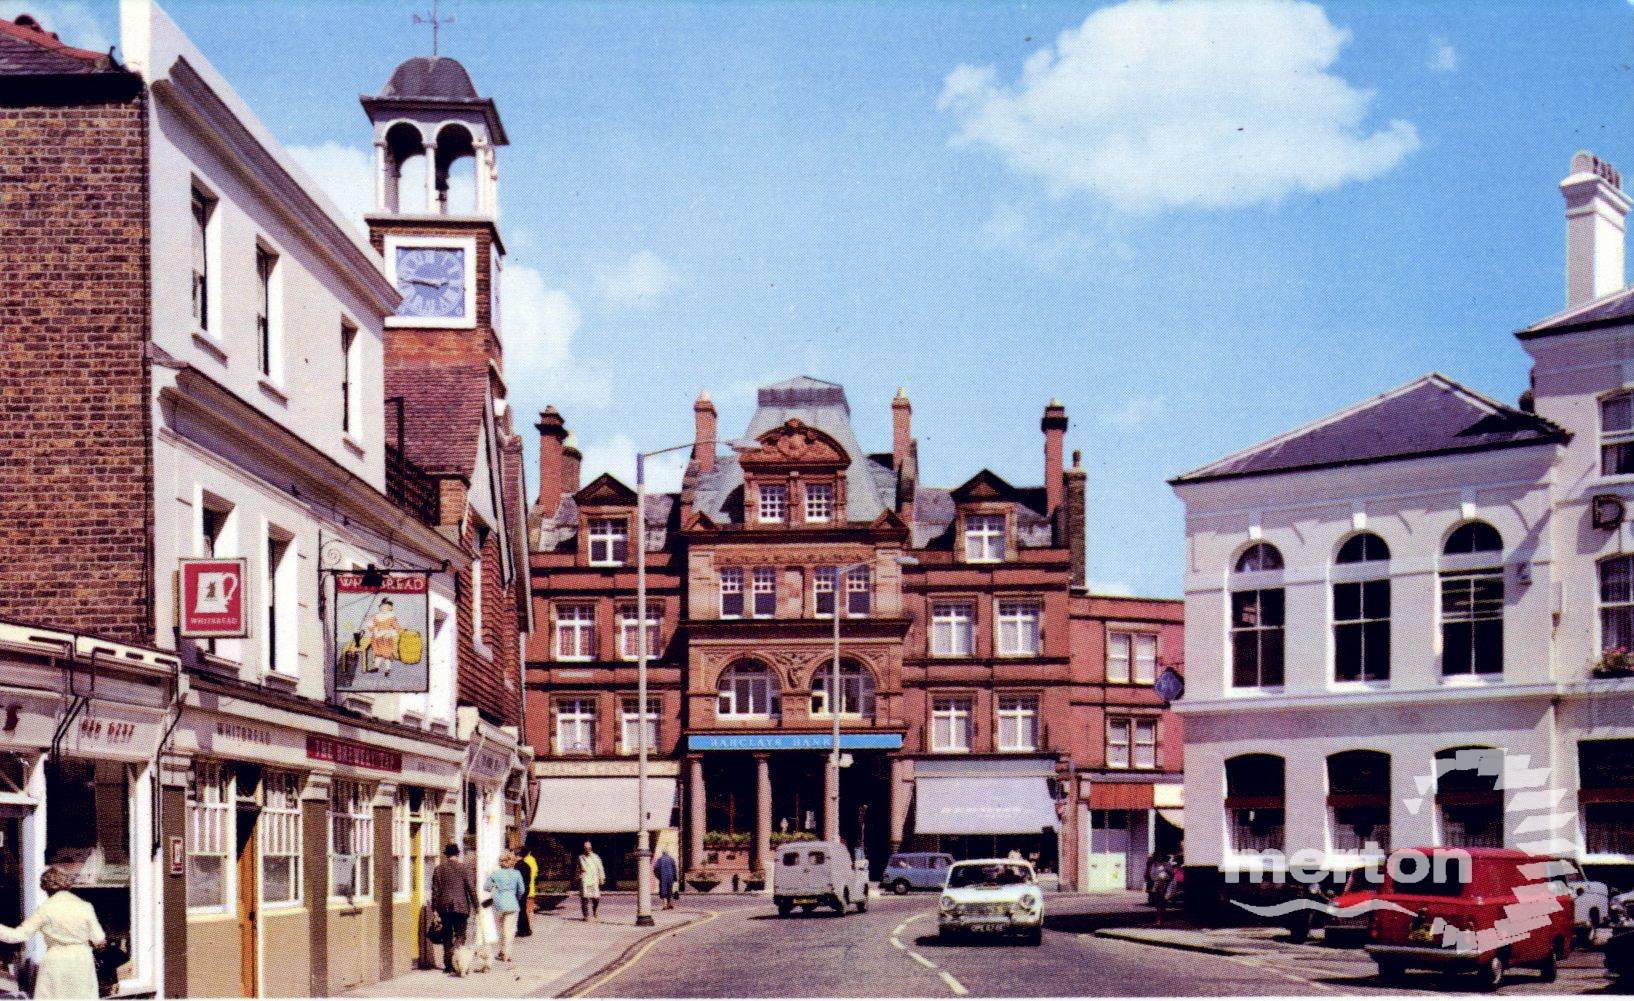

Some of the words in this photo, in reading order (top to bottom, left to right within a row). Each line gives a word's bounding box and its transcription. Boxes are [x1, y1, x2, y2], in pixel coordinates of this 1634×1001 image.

[340, 577, 424, 590] WHREAD
[217, 721, 271, 746] WHITBREAD
[315, 740, 333, 759] THE
[710, 738, 782, 747] BARCLAYS
[792, 738, 831, 747] BANK
